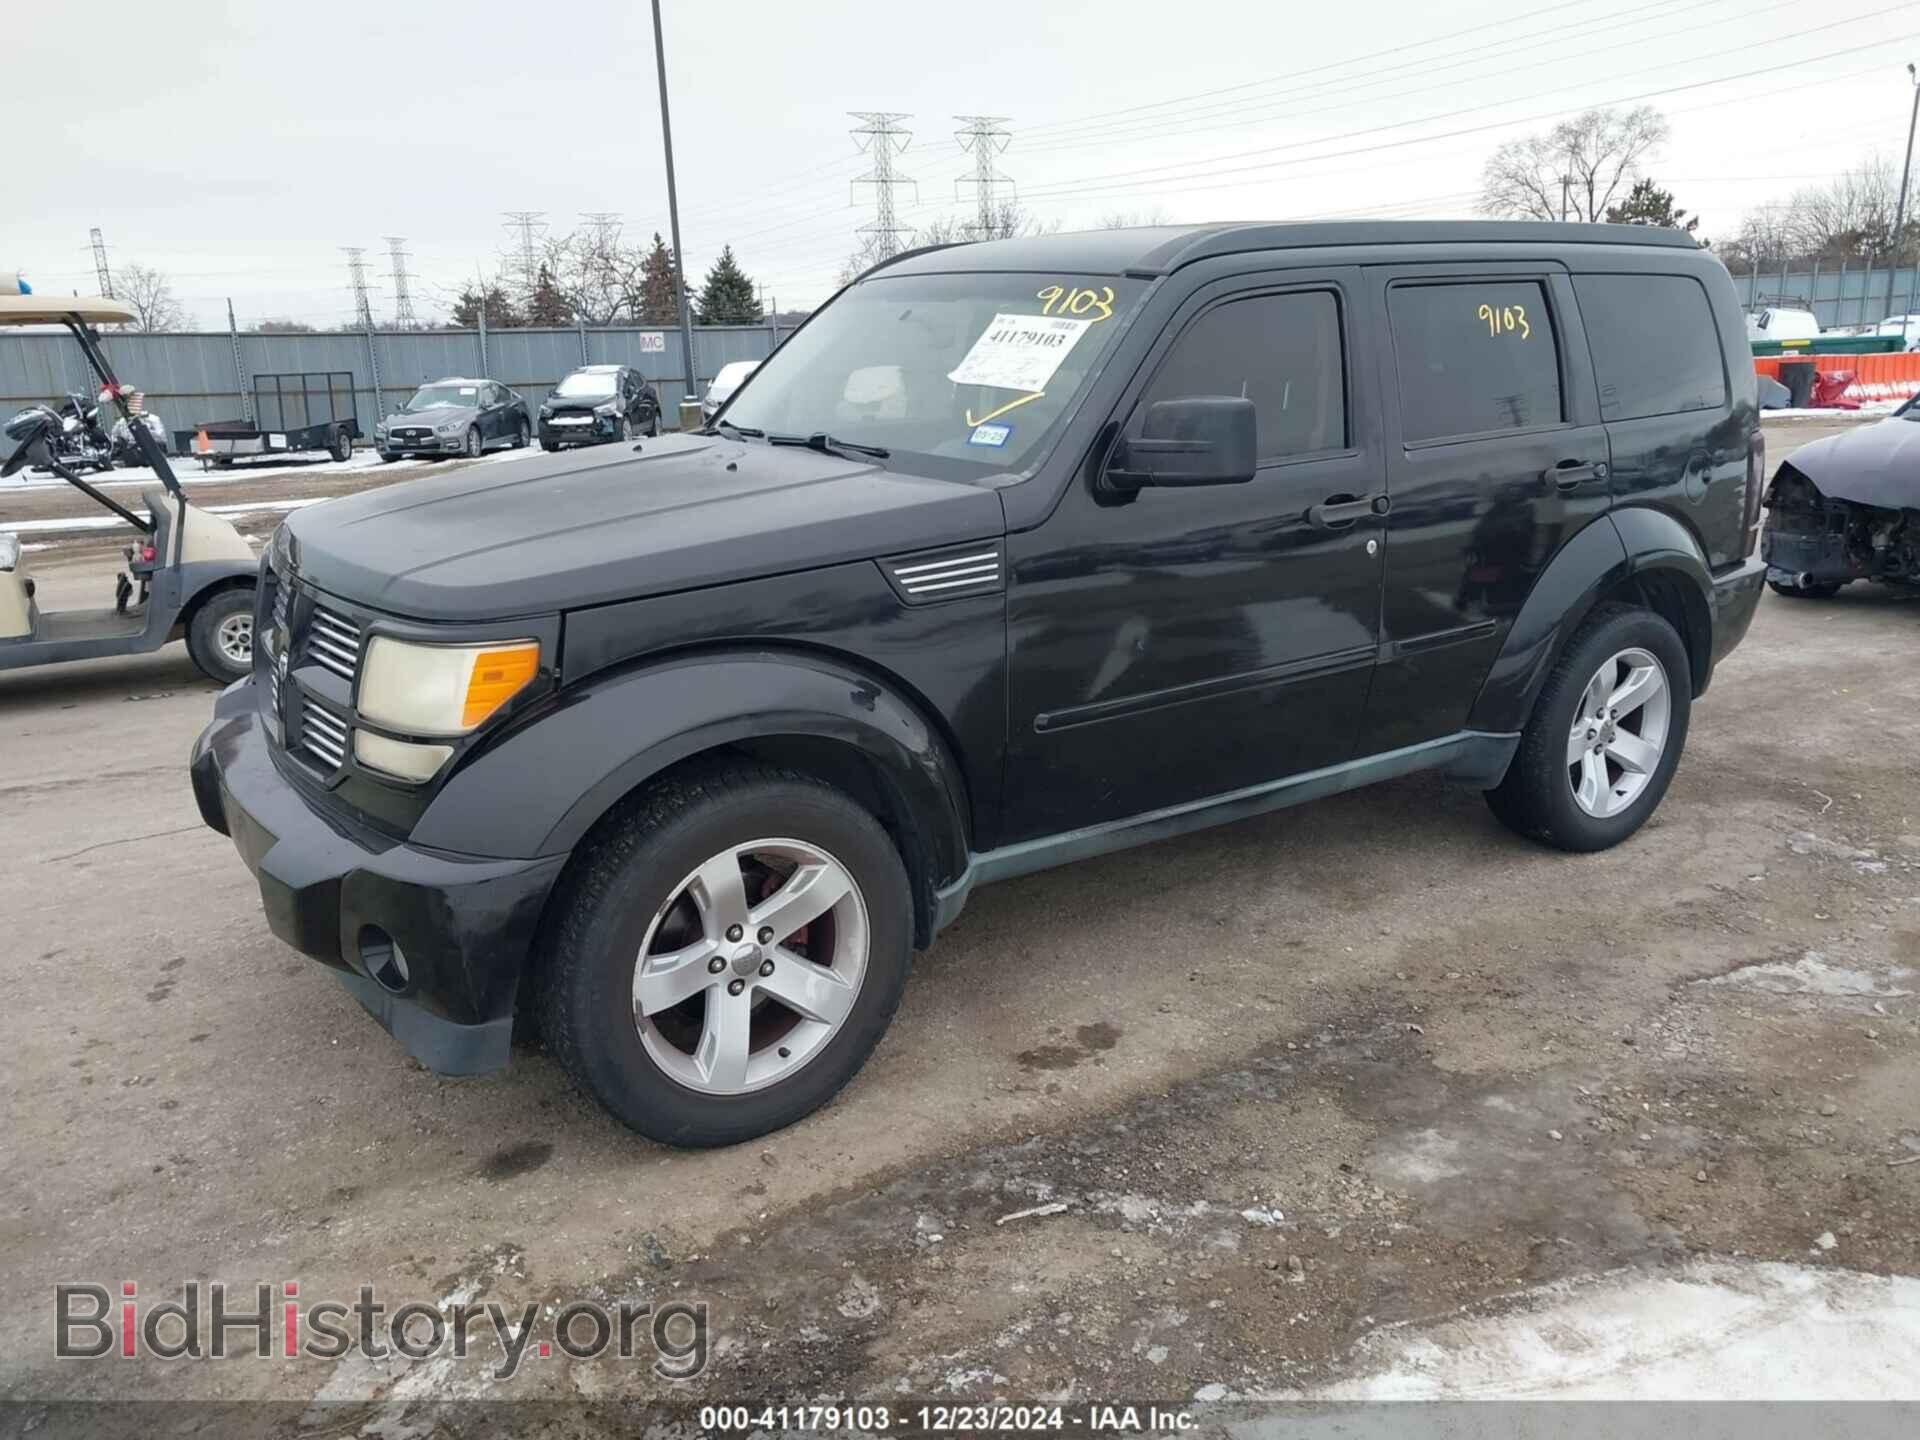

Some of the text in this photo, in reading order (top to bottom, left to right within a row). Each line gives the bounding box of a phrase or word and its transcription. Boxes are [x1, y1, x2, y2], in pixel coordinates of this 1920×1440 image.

[1036, 285, 1115, 323] 9103
[1478, 303, 1530, 340] 9103
[989, 329, 1066, 348] 41179103
